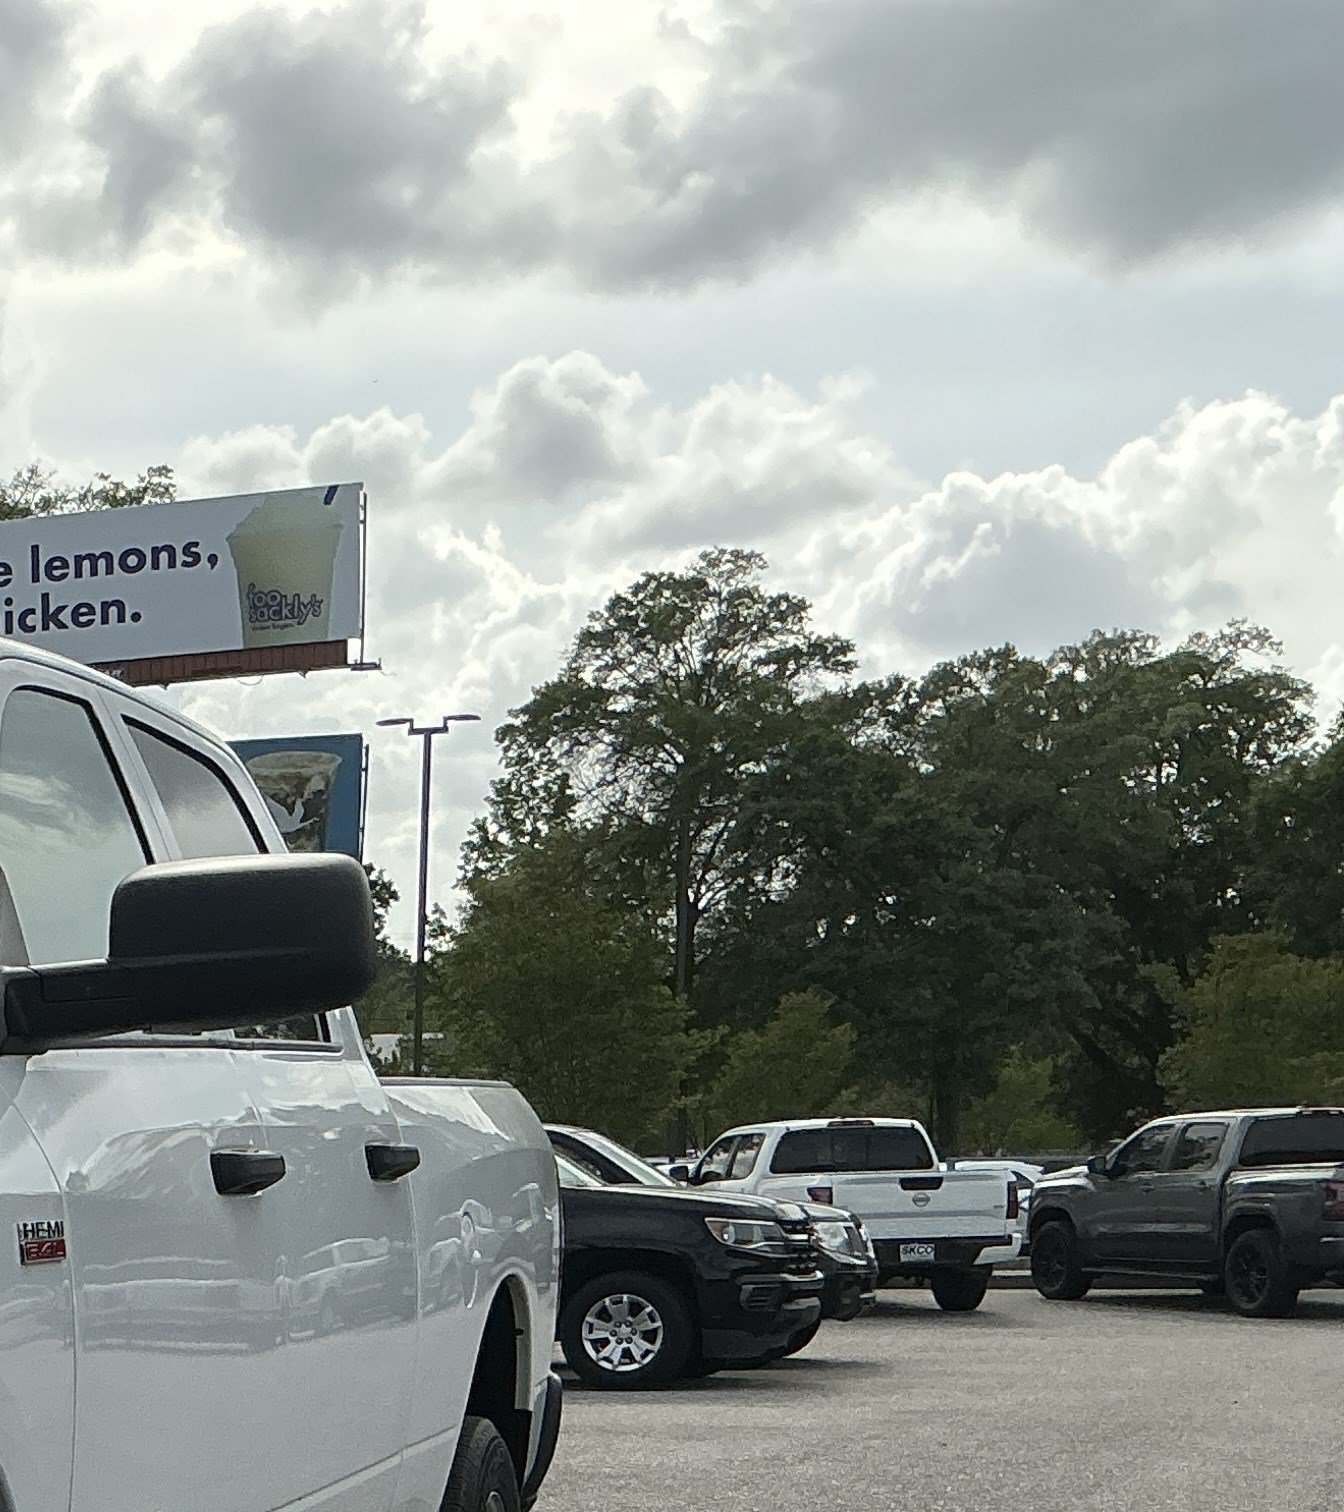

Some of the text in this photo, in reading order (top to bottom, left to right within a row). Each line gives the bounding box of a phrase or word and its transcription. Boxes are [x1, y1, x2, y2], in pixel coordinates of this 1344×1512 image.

[31, 540, 219, 584] lemons,
[22, 1220, 65, 1239] HEMI
[901, 1244, 934, 1257] SKCO
